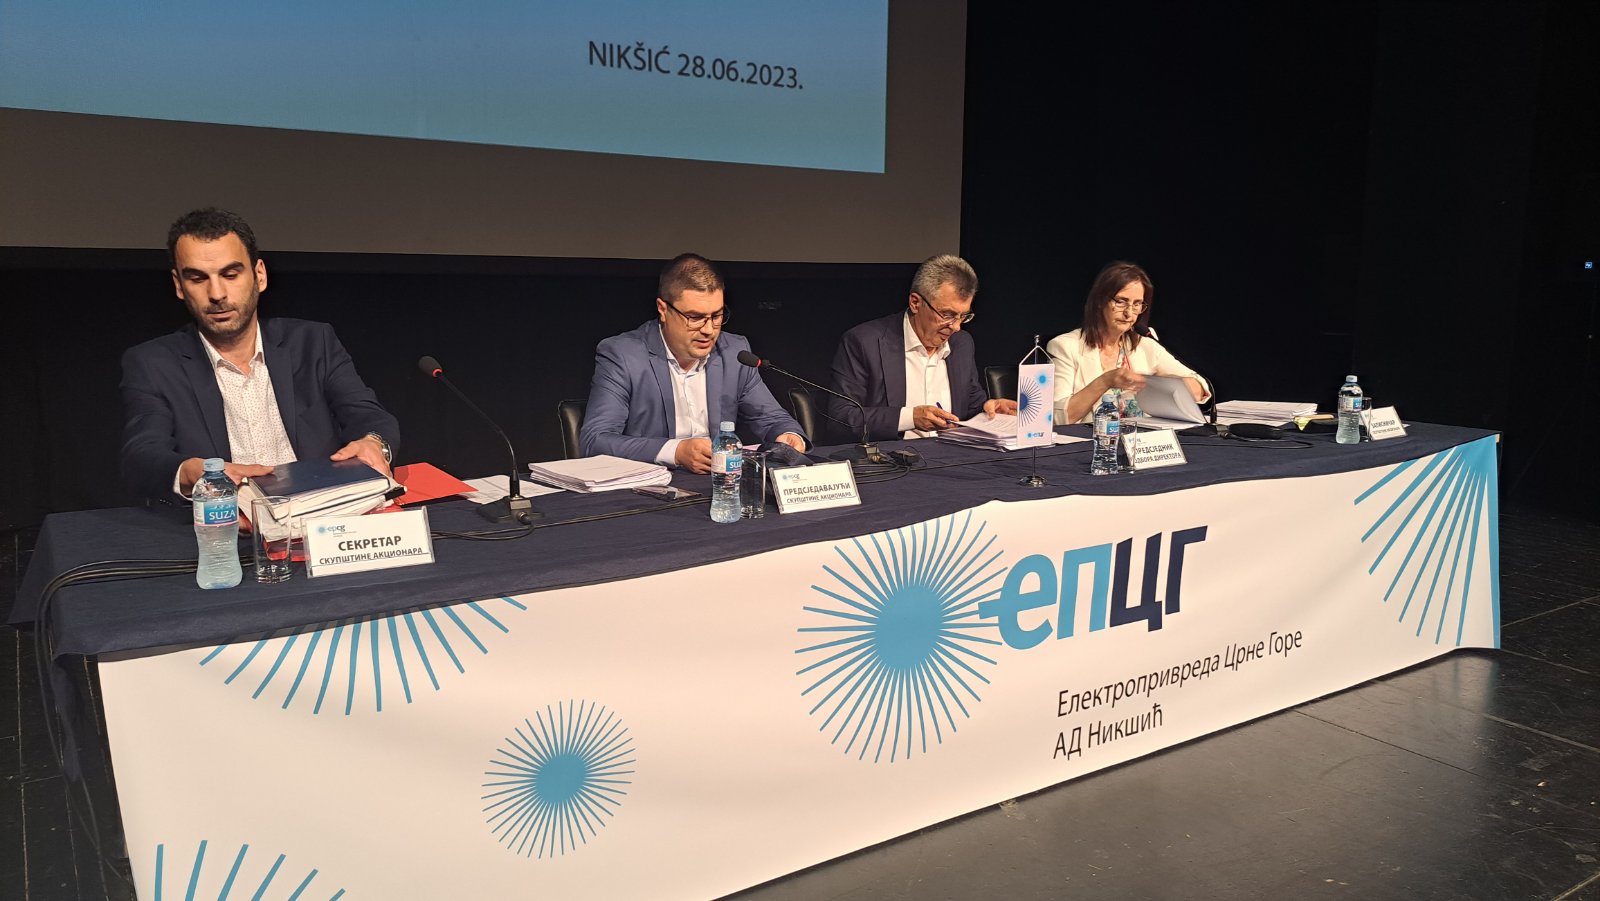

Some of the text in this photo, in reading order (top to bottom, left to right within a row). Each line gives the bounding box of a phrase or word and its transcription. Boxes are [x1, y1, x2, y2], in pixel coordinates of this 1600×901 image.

[588, 40, 804, 90] NIKŠIĆ 28.06.2023.
[783, 482, 851, 496] ПРЕДСЈЕДАВАЈУЋИ
[209, 509, 236, 521] SUZA
[338, 535, 402, 552] СЕКРЕТАР
[319, 547, 423, 565] СКУПШТИНЕ АКЦИОНАРА
[1057, 630, 1303, 718] Електропривреда Црне Горе
[1053, 702, 1163, 761] АД Никшић
